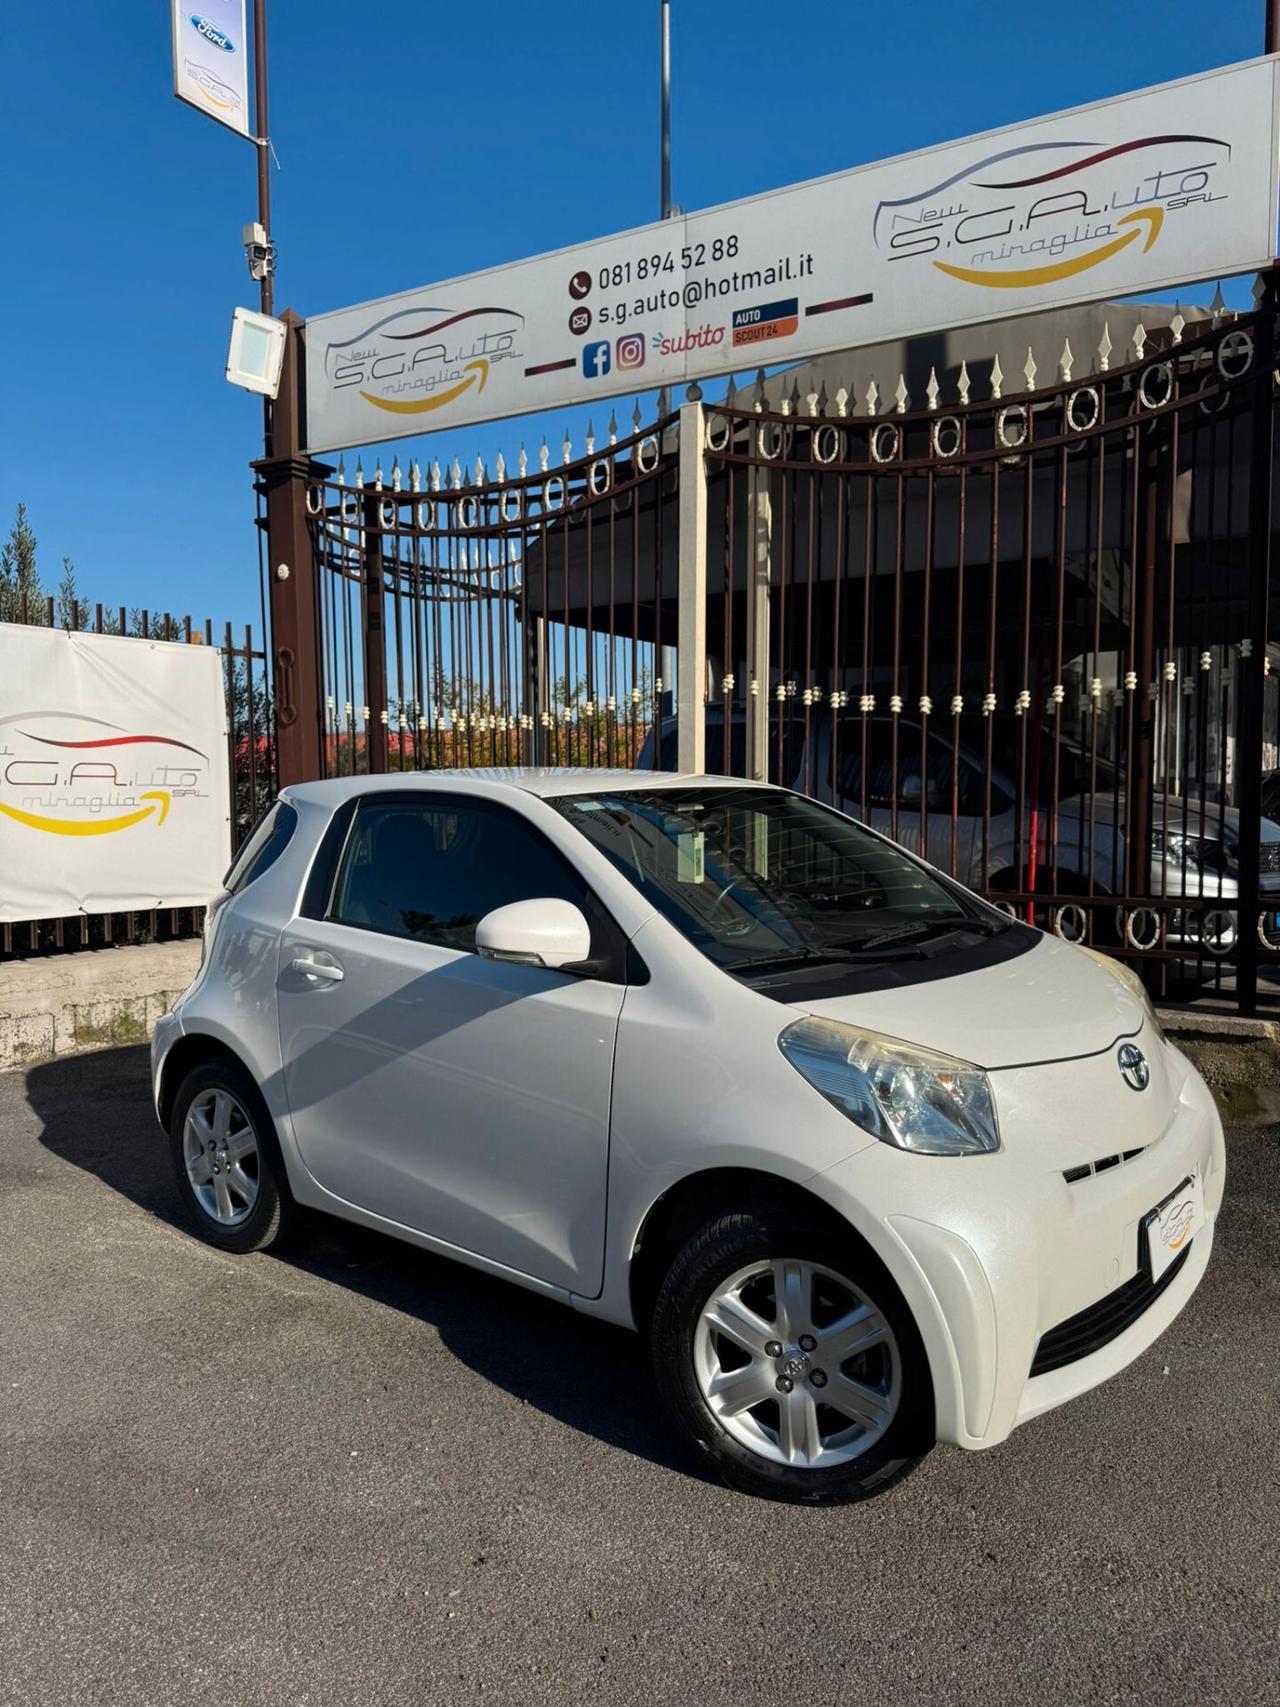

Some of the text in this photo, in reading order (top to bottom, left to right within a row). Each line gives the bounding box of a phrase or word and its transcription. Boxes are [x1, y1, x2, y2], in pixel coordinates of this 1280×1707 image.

[197, 19, 228, 48] Ford
[891, 203, 968, 230] New
[599, 234, 739, 290] 081 894 52 88
[598, 253, 814, 325] s.g.auto@hotmail.it
[735, 309, 761, 325] AUTO
[660, 324, 725, 355] subito
[735, 325, 778, 343] SCOUT 24
[335, 348, 380, 365] New
